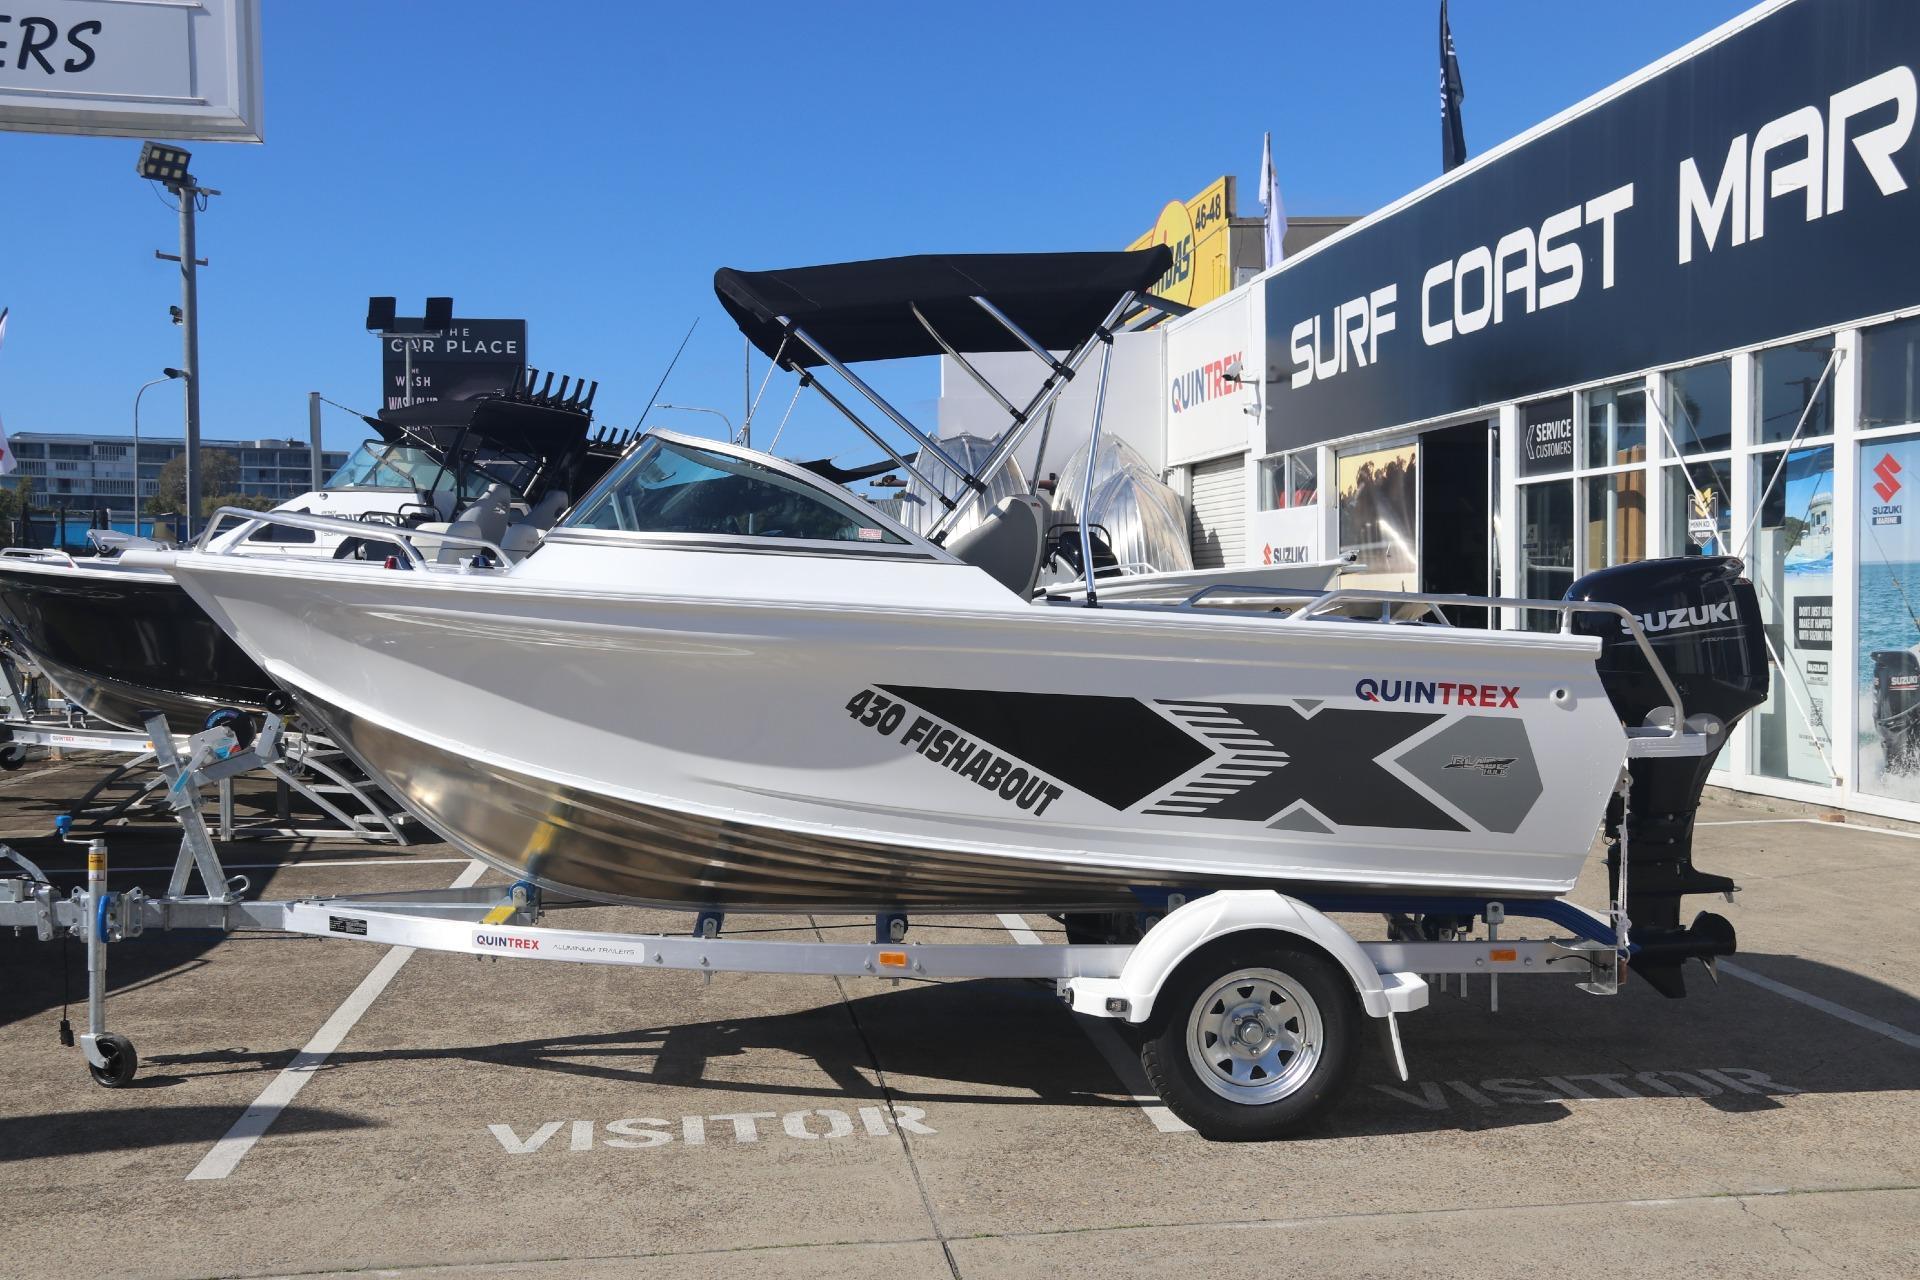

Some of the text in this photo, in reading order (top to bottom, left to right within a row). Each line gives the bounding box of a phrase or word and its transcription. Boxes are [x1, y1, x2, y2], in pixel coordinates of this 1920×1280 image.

[1195, 193, 1221, 232] 46-48
[1290, 65, 1918, 390] SURF COAST MAR
[440, 328, 470, 337] HE
[446, 340, 517, 354] PLACE
[395, 376, 431, 387] WSH
[1536, 418, 1572, 442] SERVICE
[1535, 440, 1572, 458] CUSTOMERS
[1872, 504, 1902, 515] SUZUKI
[1273, 546, 1309, 563] SUZUKI
[1620, 601, 1738, 635] SUZUKI
[1891, 676, 1918, 686] SUZUKI
[1355, 678, 1521, 709] QUINTREX
[845, 688, 1064, 817] 430 FISHABOUT
[476, 934, 636, 955] QUINTREX ALUMINIUM TRAILERS
[1374, 1067, 1803, 1112] VISITOR
[486, 1105, 938, 1154] VISITOR
